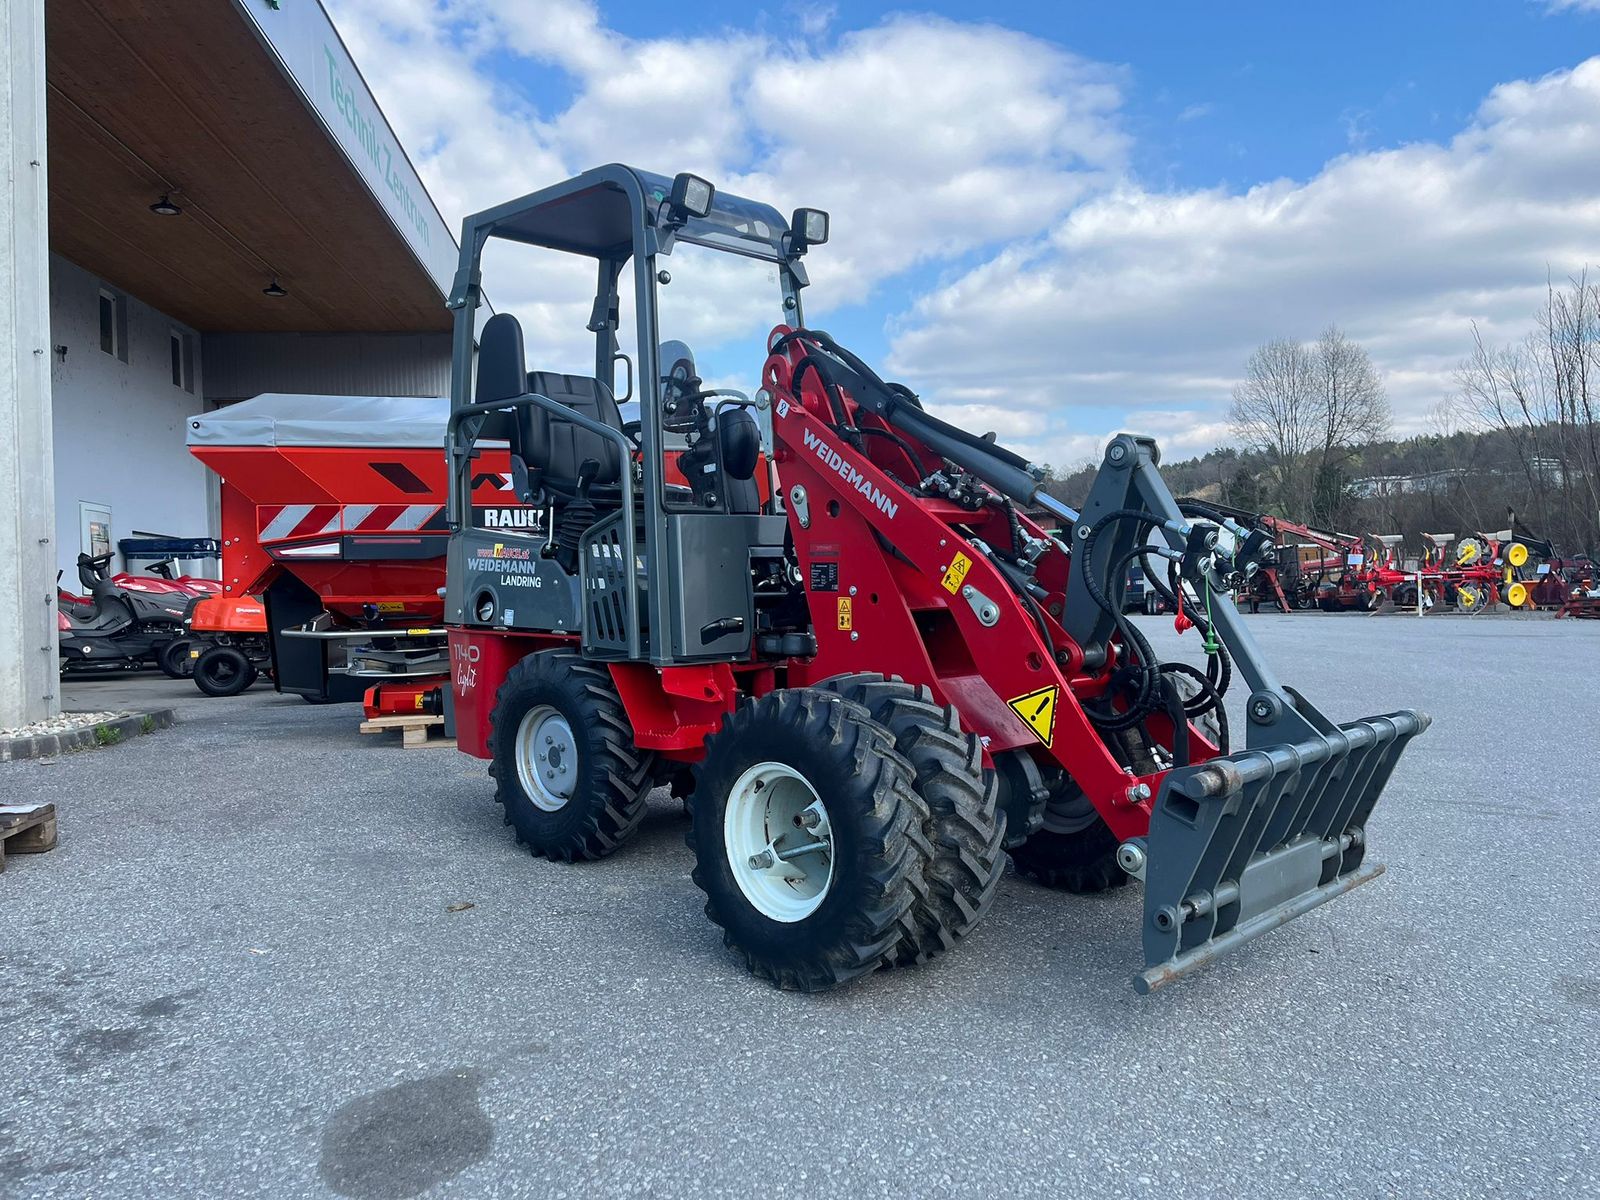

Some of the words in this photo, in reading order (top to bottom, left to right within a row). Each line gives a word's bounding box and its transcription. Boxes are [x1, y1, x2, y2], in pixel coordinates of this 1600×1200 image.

[323, 43, 382, 175] Technik
[383, 143, 430, 247] Zentrum
[803, 427, 899, 519] WEIDEMANN
[467, 558, 536, 574] WEIDEMANN
[500, 575, 541, 588] LANDRING
[453, 643, 480, 662] 1140
[457, 663, 477, 696] light
